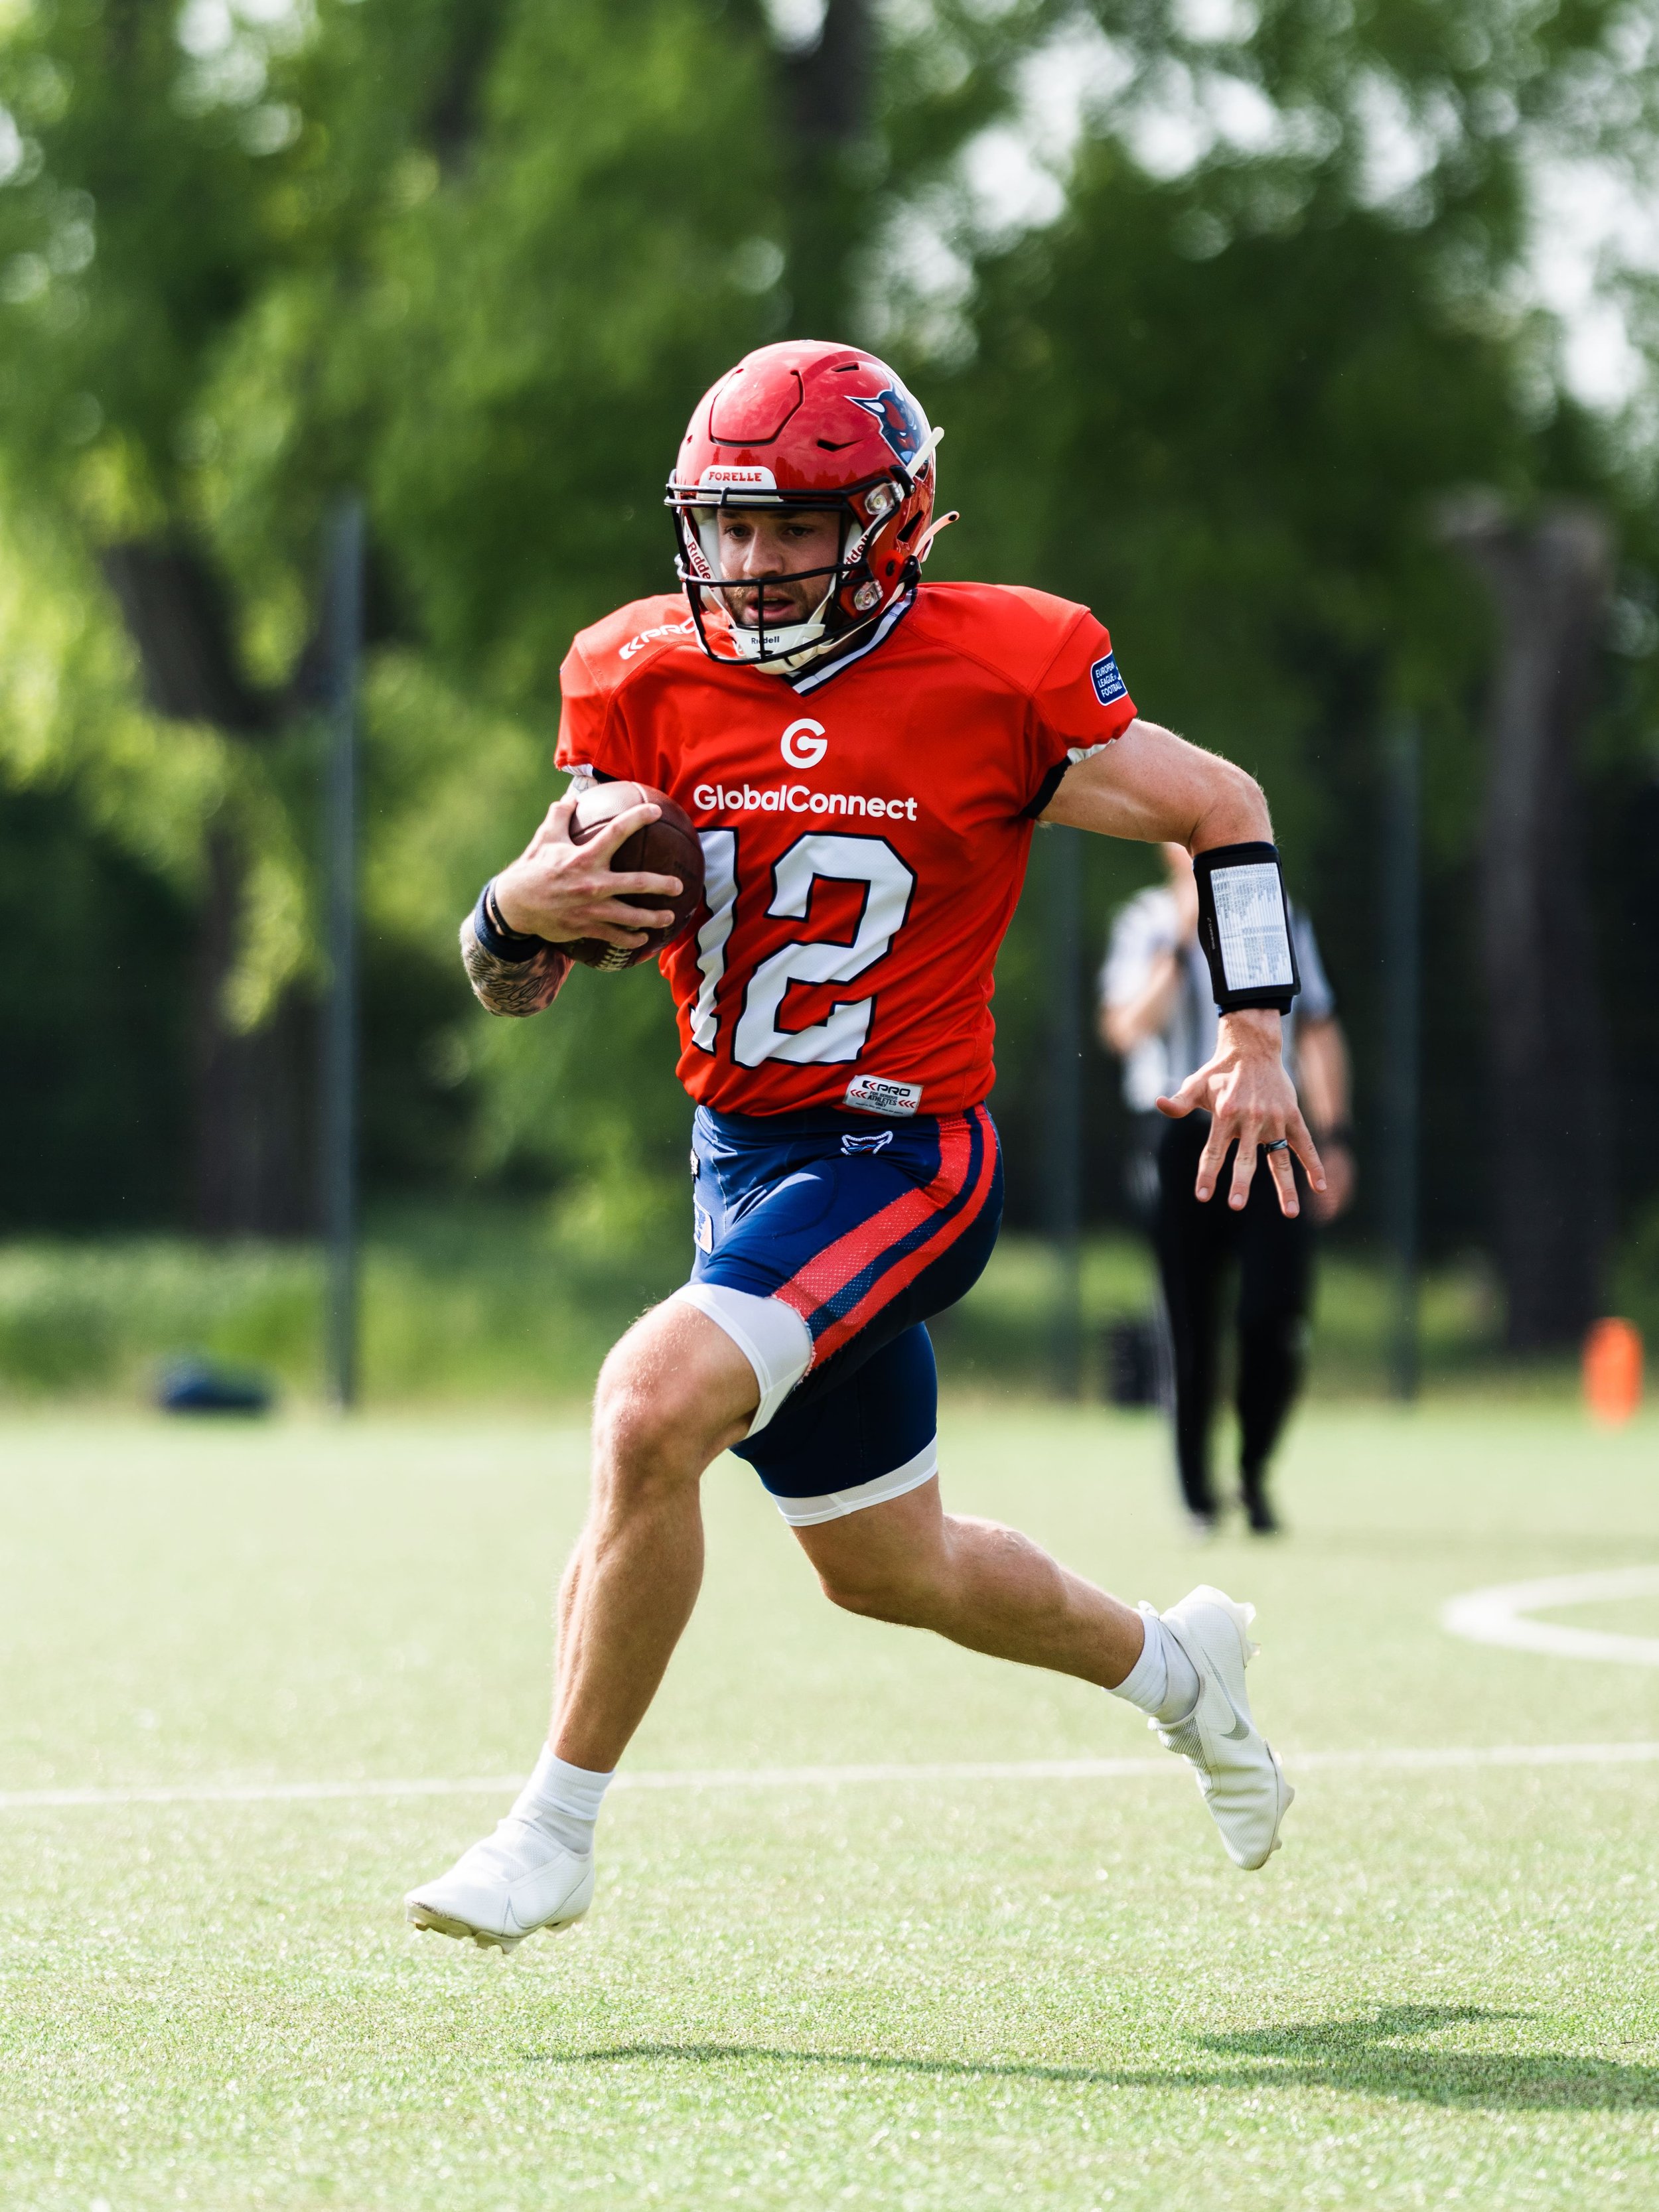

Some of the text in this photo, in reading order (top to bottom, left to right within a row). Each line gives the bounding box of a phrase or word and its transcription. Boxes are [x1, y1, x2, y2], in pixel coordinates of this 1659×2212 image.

[709, 472, 762, 482] FORELLE
[1095, 661, 1116, 679] EUROPEAN
[1098, 673, 1114, 688] LEAGUE
[1100, 681, 1123, 698] FOOTBALL
[693, 784, 918, 822] GlobalConnect
[690, 827, 918, 1070] 12
[867, 1095, 897, 1106] ATHLETES
